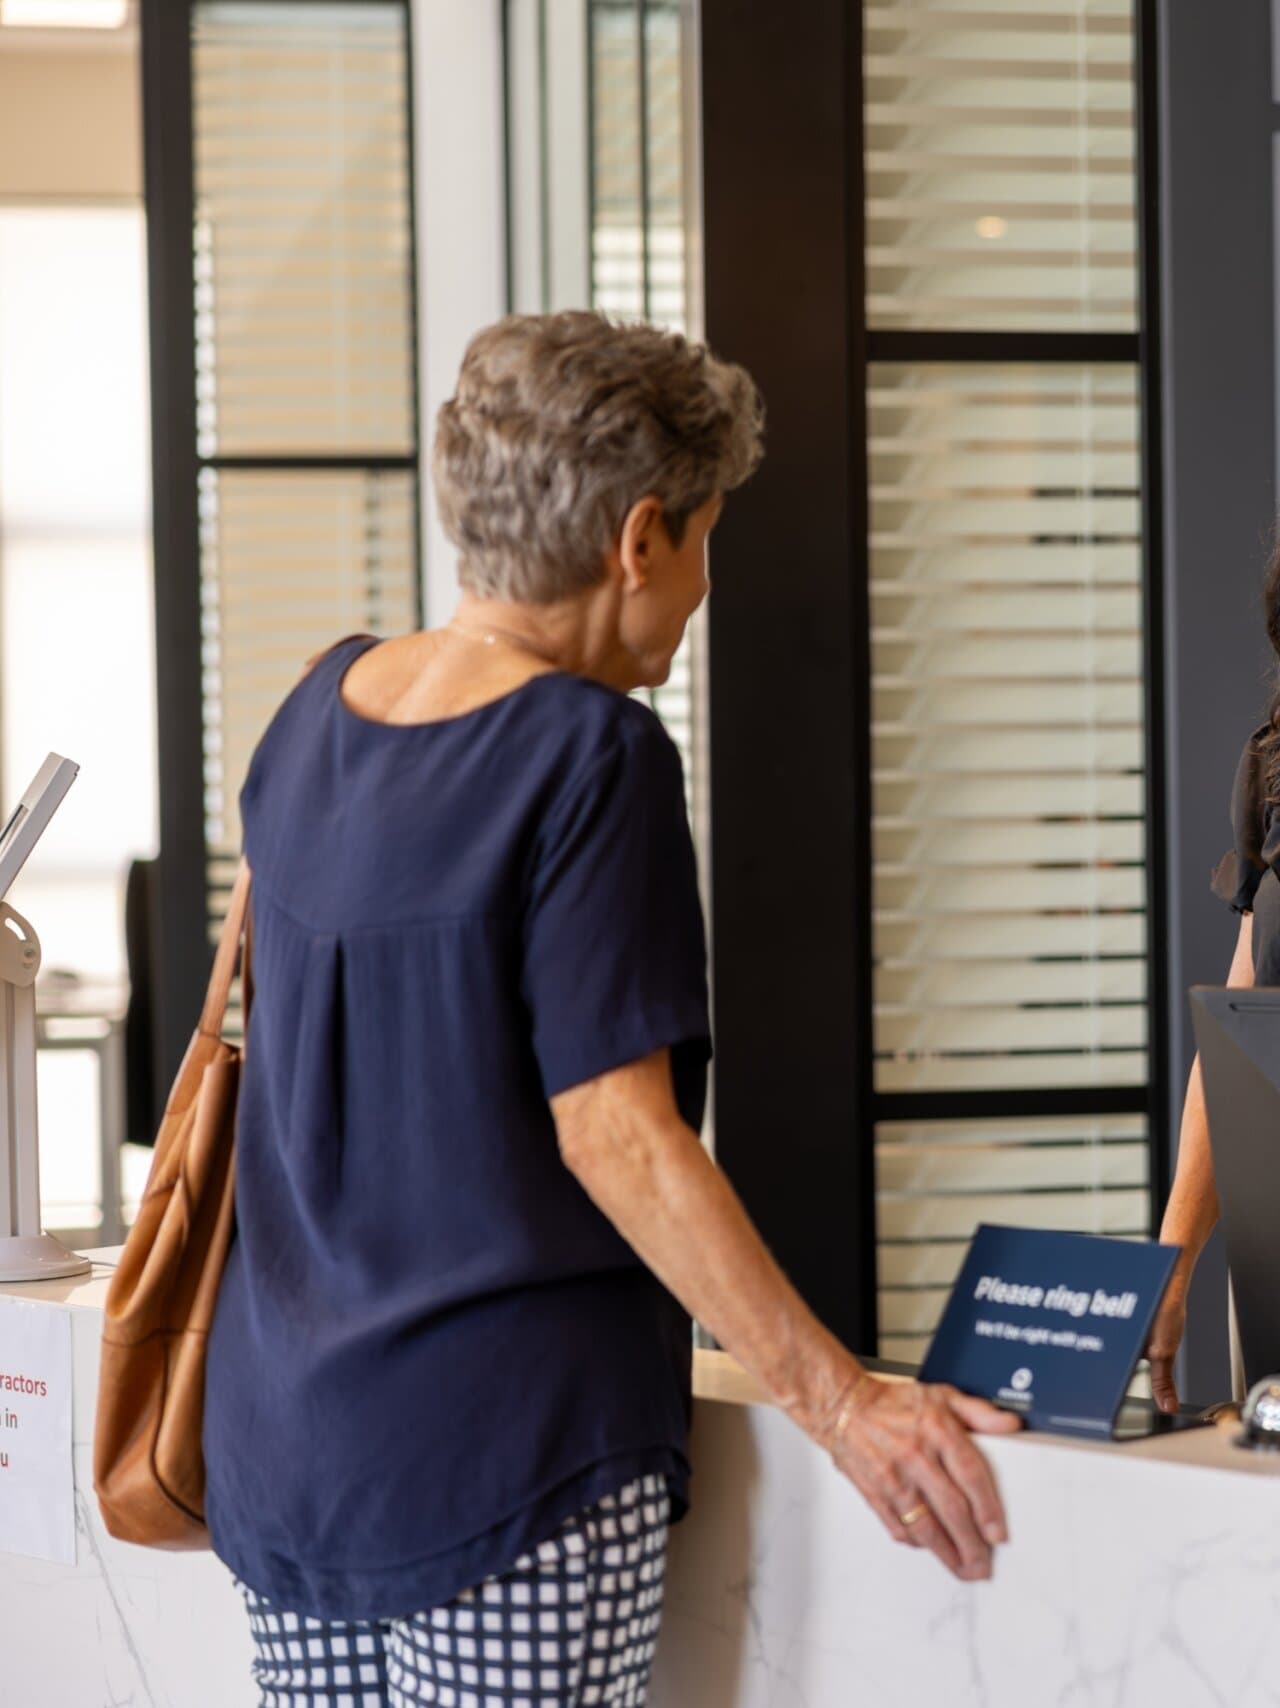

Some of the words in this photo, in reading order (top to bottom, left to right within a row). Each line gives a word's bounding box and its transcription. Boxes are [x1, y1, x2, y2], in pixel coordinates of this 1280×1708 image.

[974, 1275, 1044, 1308] Please
[1043, 1284, 1091, 1318] ring
[1089, 1288, 1138, 1319] bell
[1003, 1322, 1021, 1341] be
[1021, 1326, 1050, 1346] right
[1050, 1330, 1077, 1348] with
[5, 1407, 18, 1429] in
